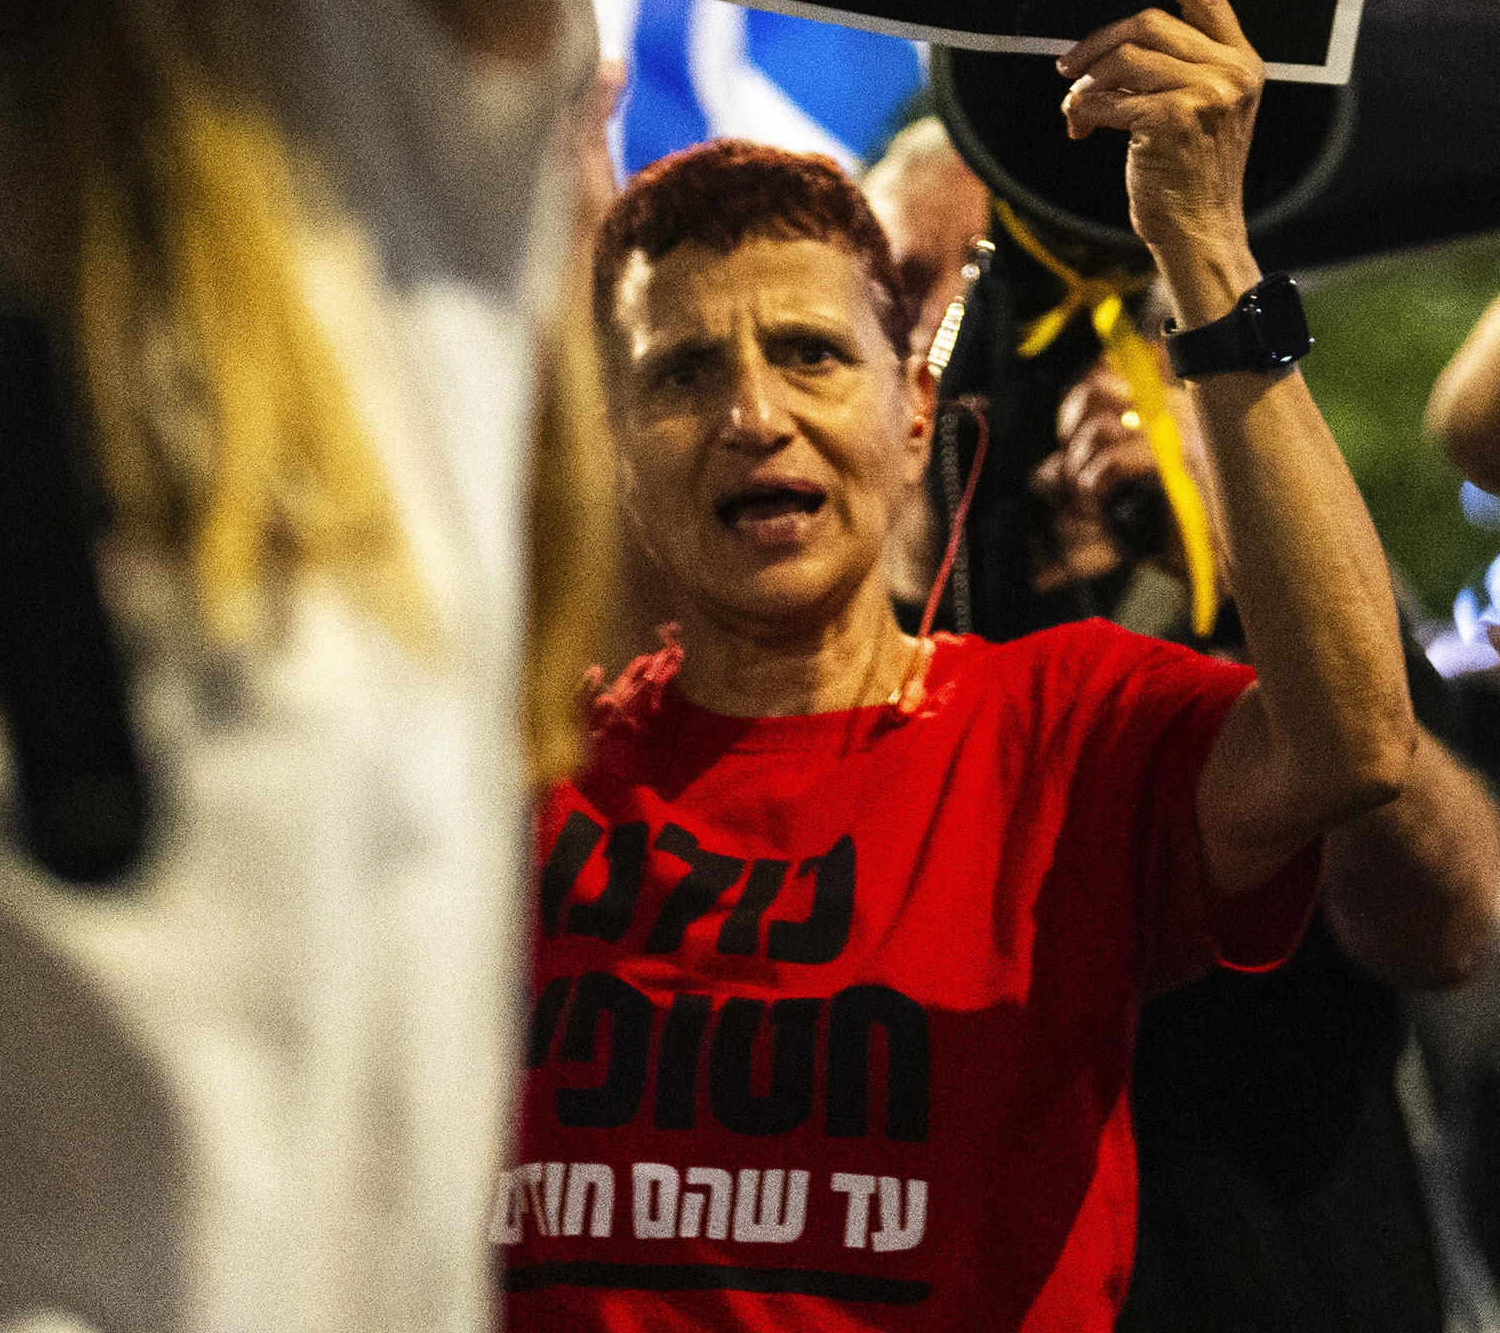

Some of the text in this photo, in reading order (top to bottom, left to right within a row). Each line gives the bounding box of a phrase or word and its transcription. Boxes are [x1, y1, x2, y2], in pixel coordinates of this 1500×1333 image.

[527, 971, 930, 1141] חטופי
[632, 1161, 811, 1244] שהם
[831, 1171, 930, 1254] עד
